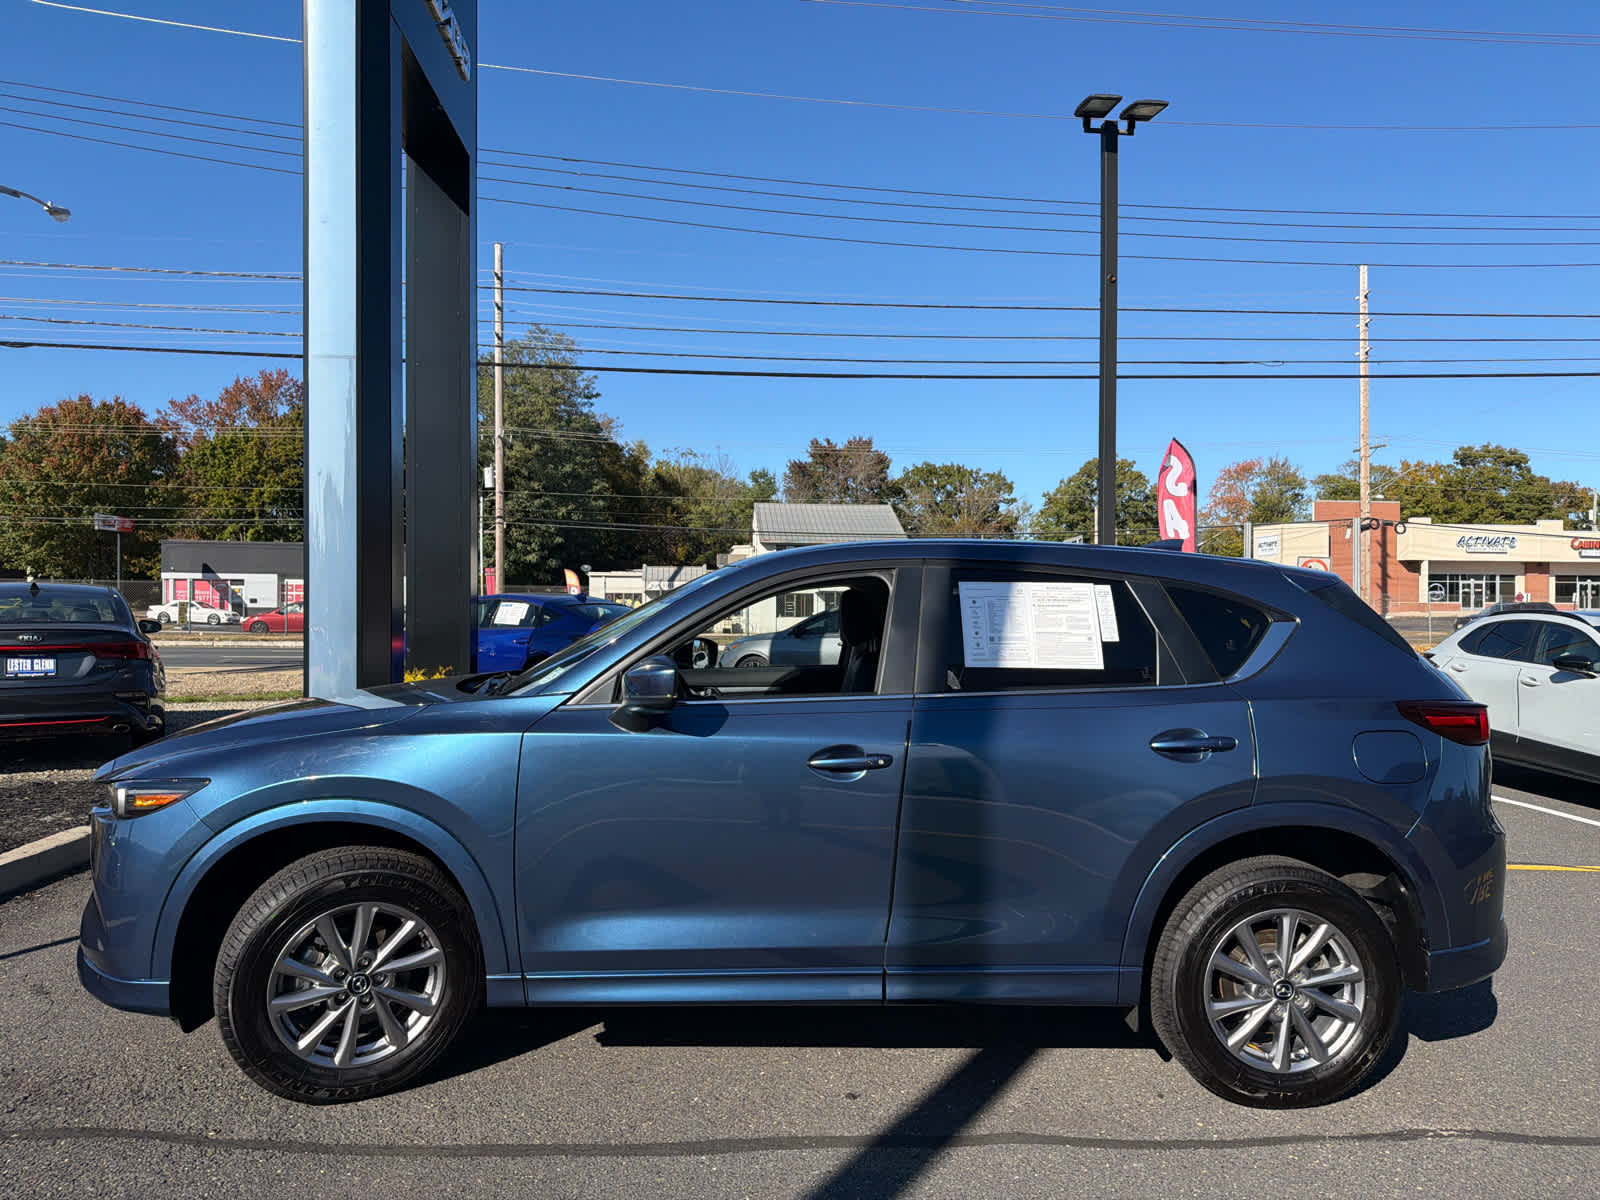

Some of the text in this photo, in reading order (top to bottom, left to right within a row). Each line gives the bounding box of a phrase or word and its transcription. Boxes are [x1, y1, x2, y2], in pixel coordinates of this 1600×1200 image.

[1457, 536, 1517, 547] ACTIVATE
[7, 658, 55, 671] LESTER GLENN
